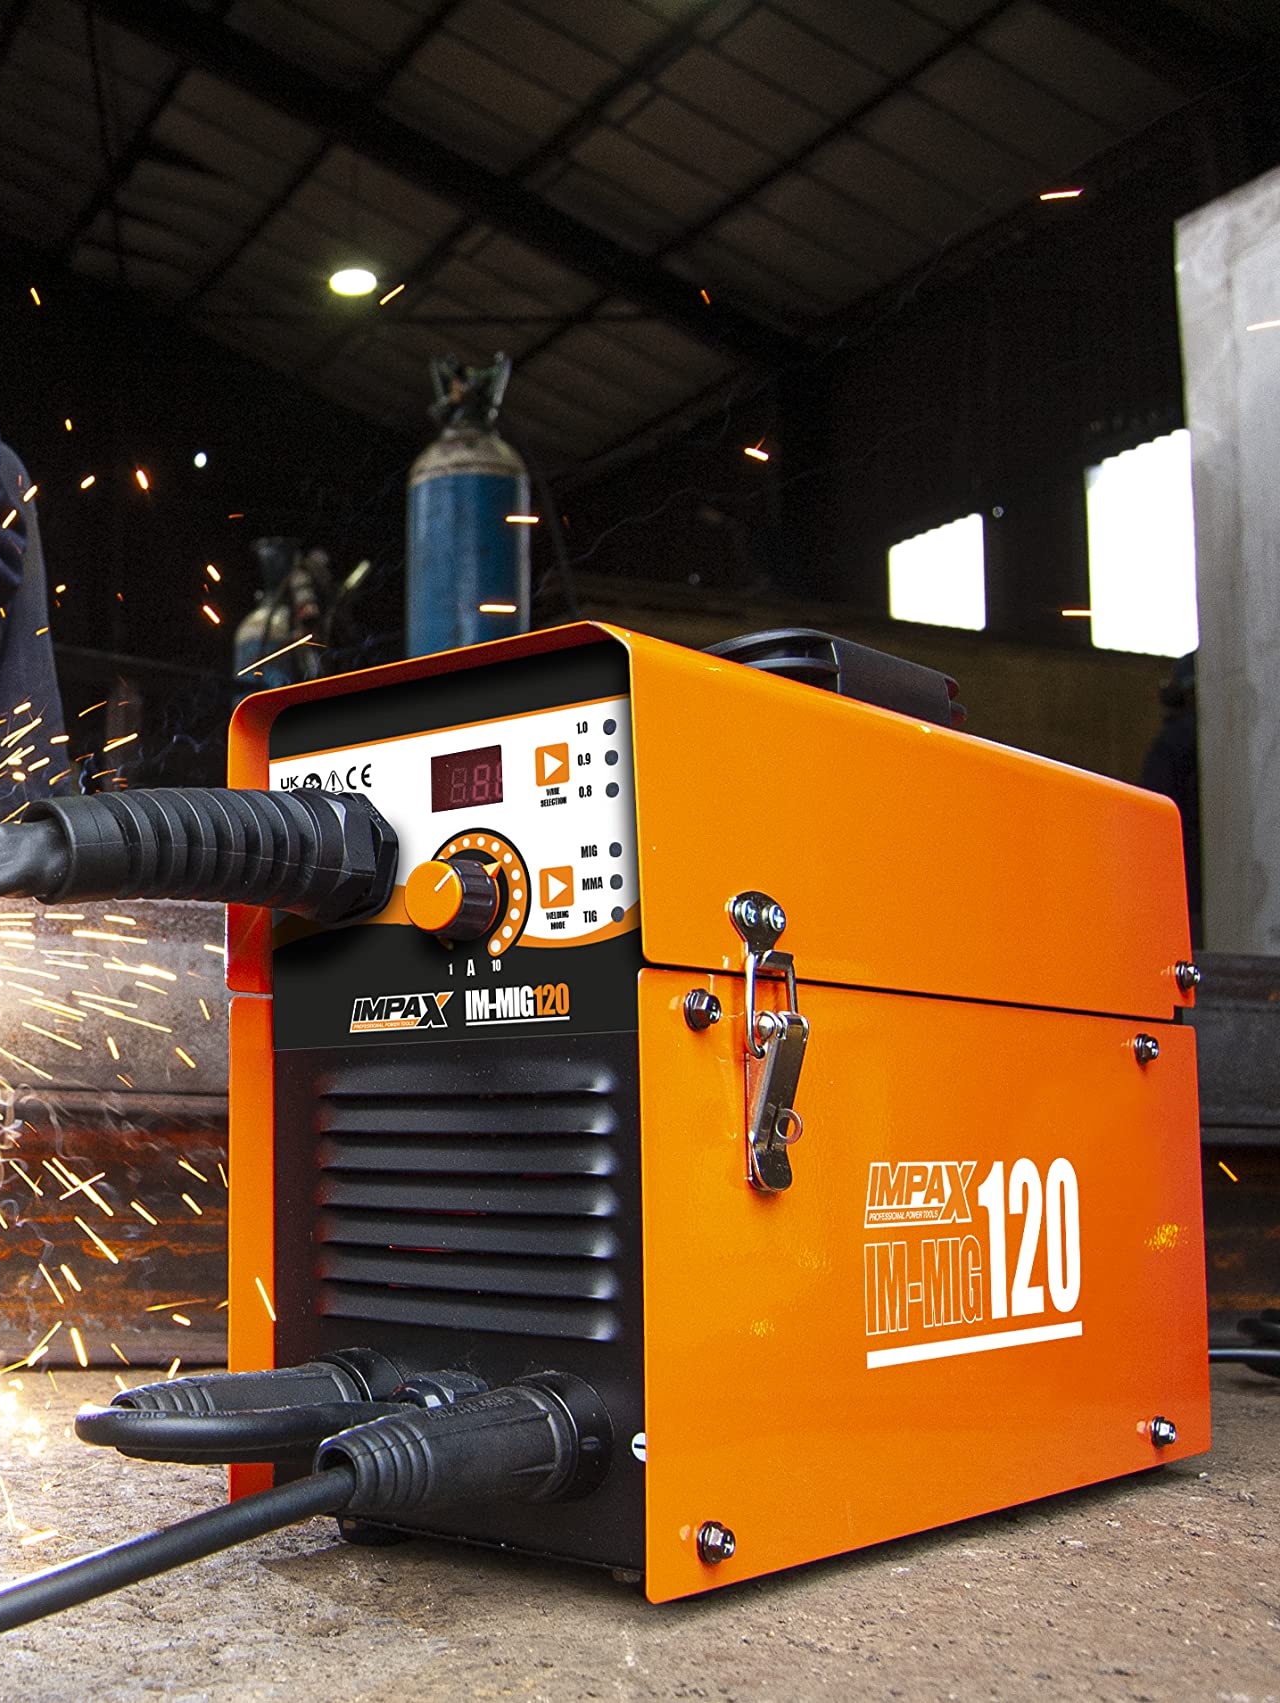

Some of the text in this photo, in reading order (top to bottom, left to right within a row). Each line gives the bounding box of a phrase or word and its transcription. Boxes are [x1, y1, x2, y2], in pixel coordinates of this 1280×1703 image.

[576, 721, 588, 734] 1.0
[577, 752, 591, 766] 0.9
[280, 775, 299, 790] UK
[345, 763, 372, 790] CE
[578, 784, 592, 798] 0.8
[540, 796, 567, 808] SELECTION
[580, 844, 598, 858] MIG
[582, 876, 603, 891] MMA
[545, 910, 569, 920] WELDING
[583, 910, 598, 923] TIG
[550, 921, 566, 930] MODE
[448, 963, 454, 975] 1
[466, 958, 476, 977] A
[491, 959, 501, 972] 10
[352, 991, 454, 1028] IMPAX
[353, 1021, 384, 1029] PROFESSIONAL
[867, 1161, 977, 1223] IMPAX
[869, 1209, 939, 1222] PROFESSIONAL POWER TOOLS
[977, 1157, 1081, 1320] 120
[864, 1235, 983, 1336] IM-MIG
